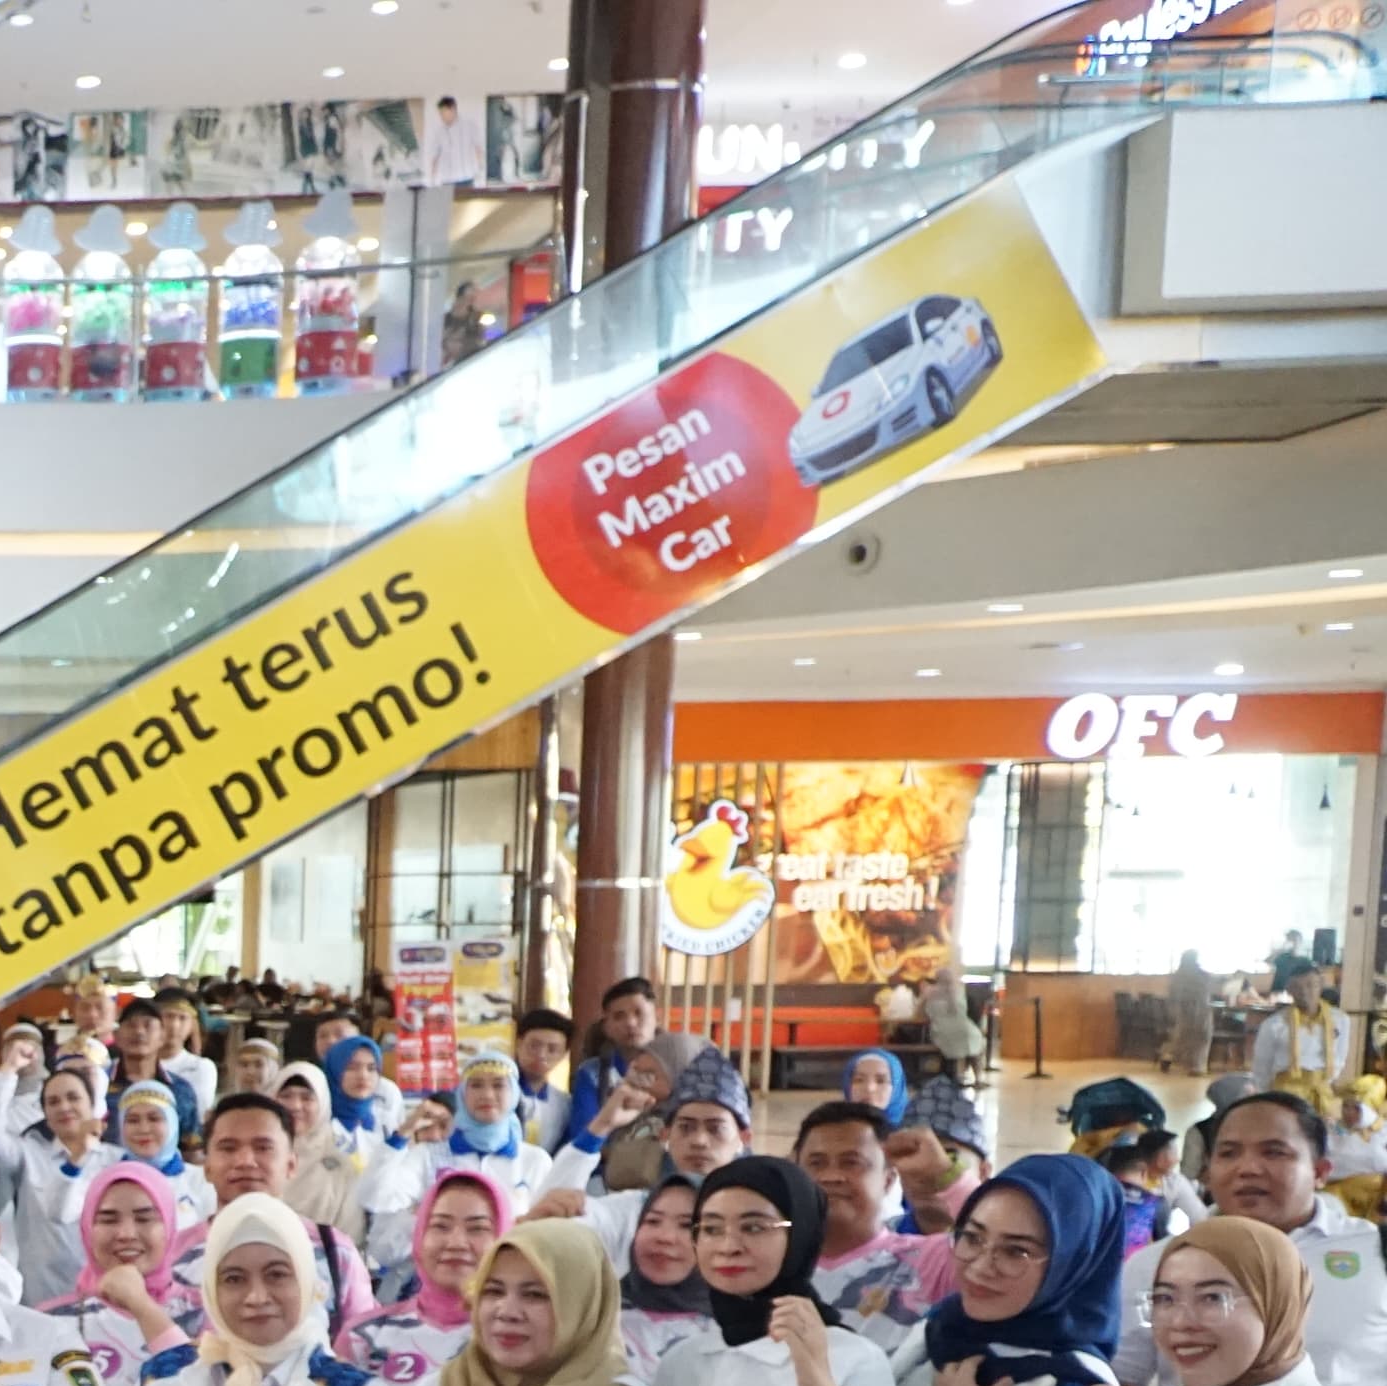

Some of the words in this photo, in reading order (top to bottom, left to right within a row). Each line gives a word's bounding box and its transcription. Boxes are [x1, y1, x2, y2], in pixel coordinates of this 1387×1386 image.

[582, 408, 712, 496] Pesan
[597, 451, 747, 548] Maxim
[659, 515, 732, 572] Car
[222, 571, 429, 713] terus
[209, 622, 492, 840] promo!
[1047, 692, 1239, 758] OFC
[832, 851, 909, 881] taste
[394, 1356, 415, 1380] 2
